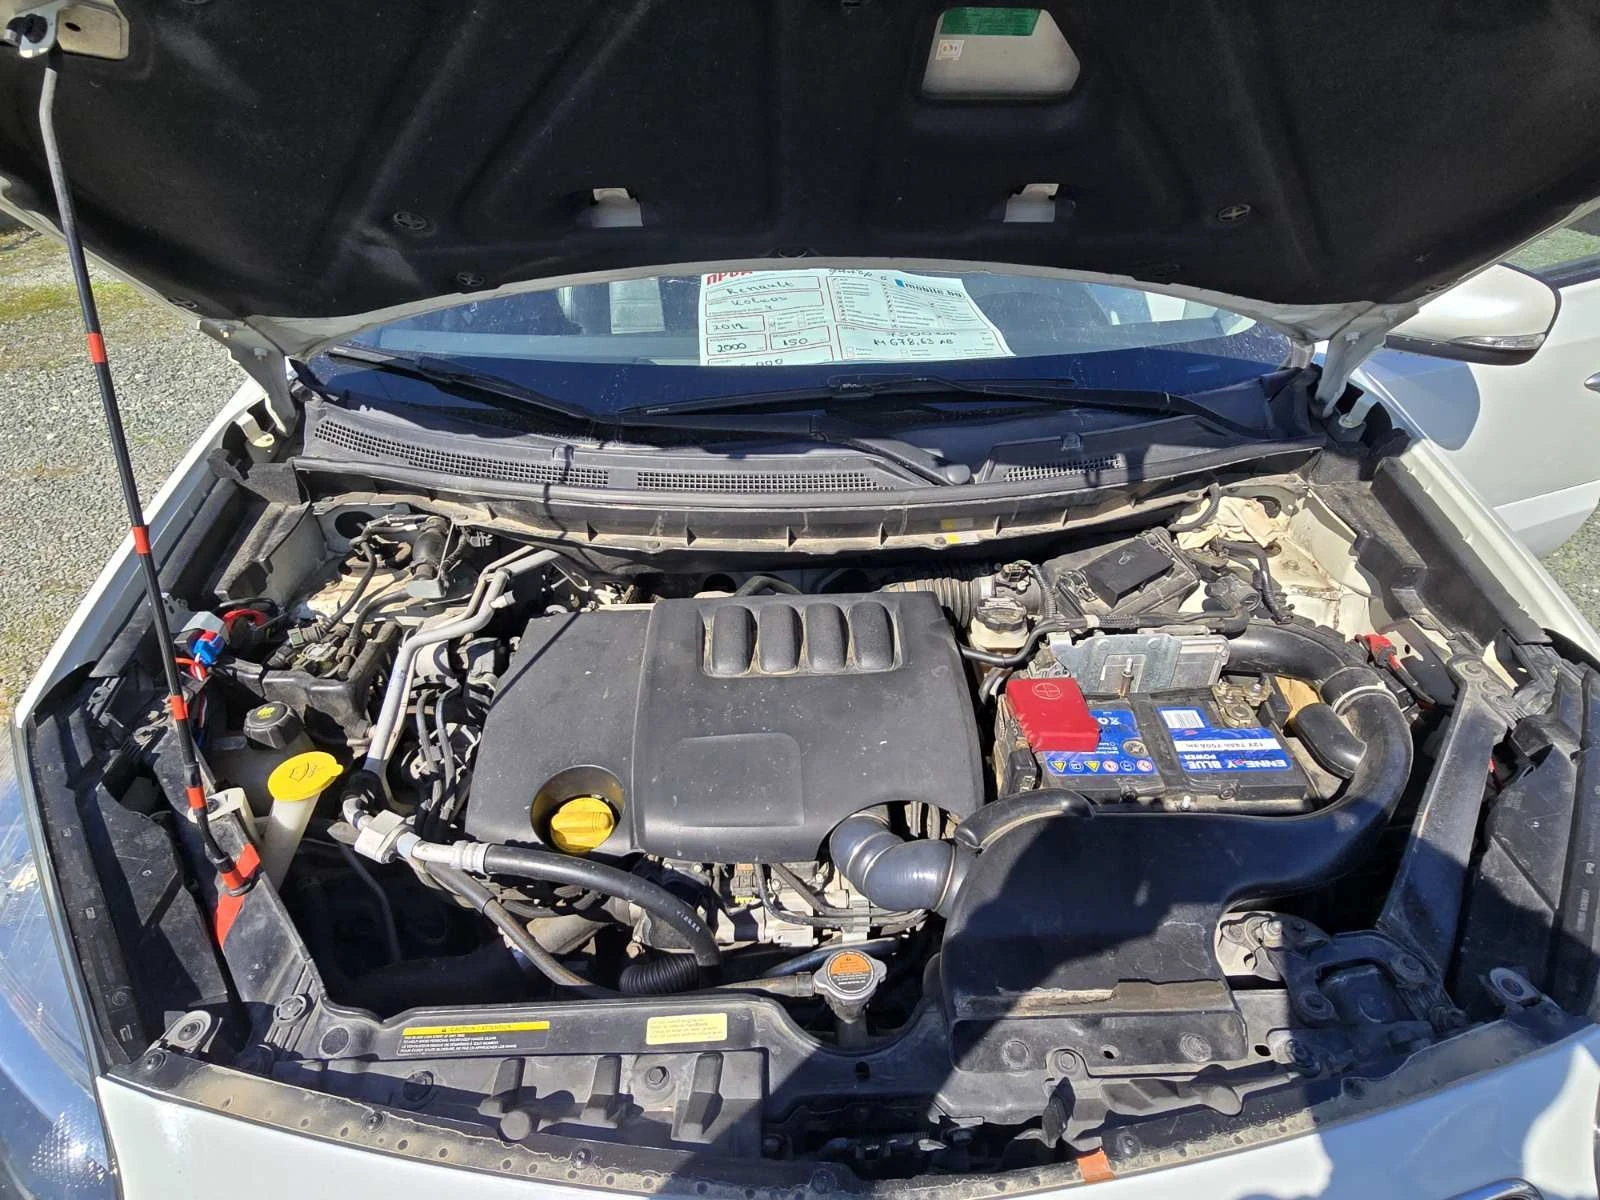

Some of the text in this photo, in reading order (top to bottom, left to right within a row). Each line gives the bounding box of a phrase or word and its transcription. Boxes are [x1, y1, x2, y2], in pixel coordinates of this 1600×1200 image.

[725, 280, 795, 295] Renault
[904, 281, 963, 298] mobile.bg
[782, 337, 809, 347] 150
[716, 342, 748, 354] 2000
[1182, 752, 1217, 760] POWER
[1185, 759, 1223, 769] BLUE
